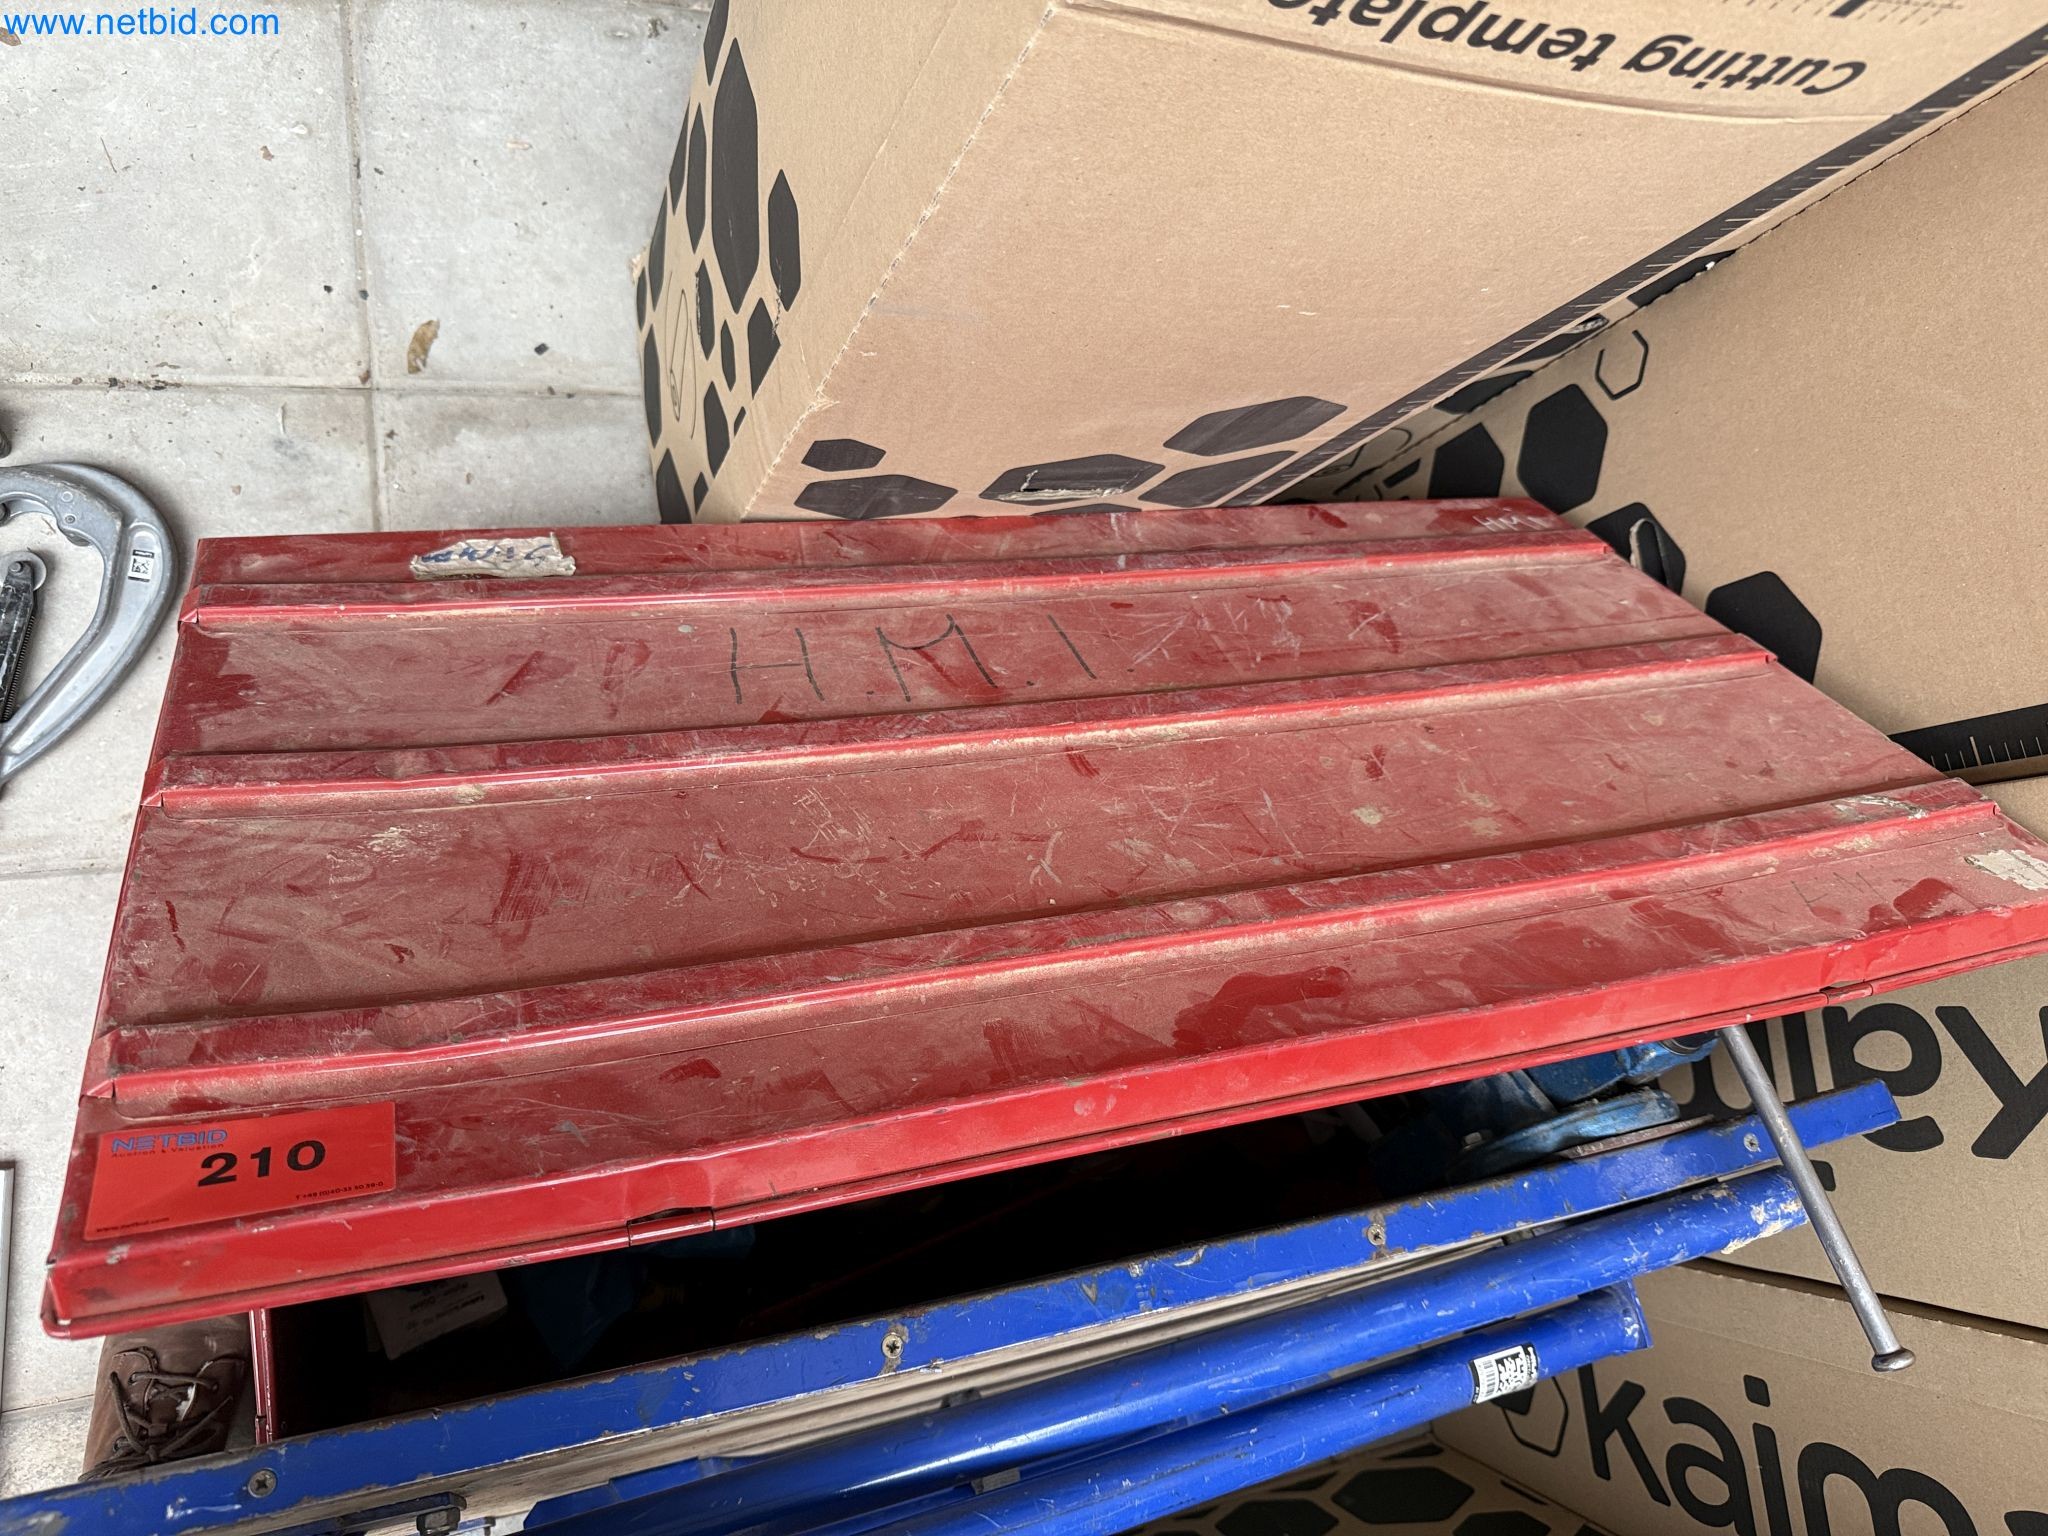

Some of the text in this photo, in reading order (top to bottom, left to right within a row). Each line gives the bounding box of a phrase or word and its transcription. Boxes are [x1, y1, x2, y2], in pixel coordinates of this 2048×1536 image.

[1267, 0, 1867, 95] Cutting templat
[112, 1128, 228, 1153] NETBID
[198, 1139, 327, 1188] 210
